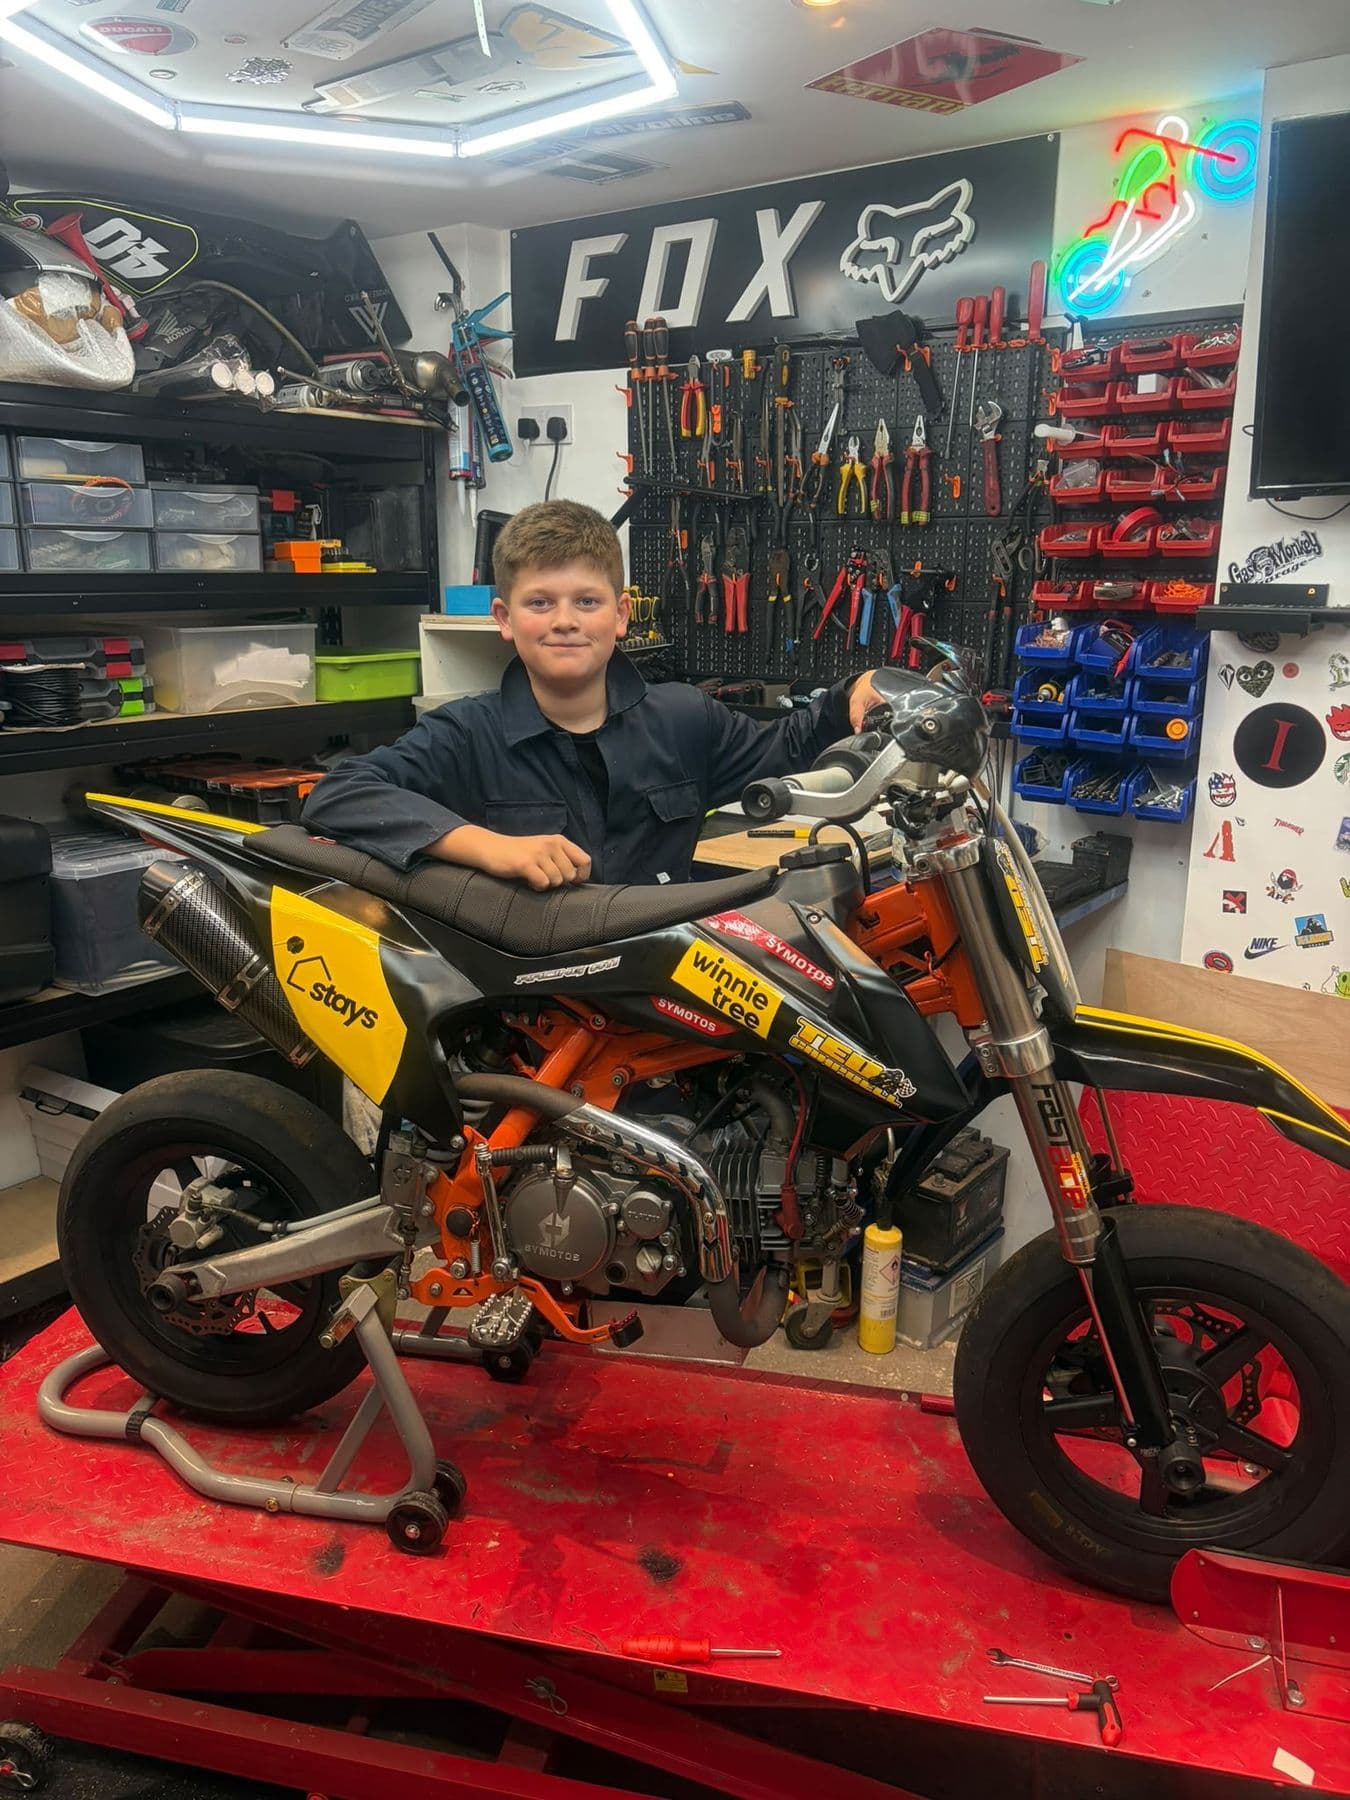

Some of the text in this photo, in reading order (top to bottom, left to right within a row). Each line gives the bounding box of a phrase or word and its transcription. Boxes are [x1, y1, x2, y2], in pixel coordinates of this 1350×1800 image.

[100, 26, 163, 34] DUCATI
[554, 200, 826, 342] FOX
[164, 324, 196, 344] HONDA
[1228, 530, 1322, 584] Gas Monkey
[1256, 559, 1308, 584] arage
[766, 936, 835, 987] SYMOTOS
[1250, 938, 1278, 949] NIKE
[692, 950, 769, 1011] winnie
[309, 982, 379, 1029] stays
[657, 997, 716, 1032] SYMOTOS
[712, 986, 761, 1030] tree
[797, 1017, 885, 1079] TED
[524, 1245, 581, 1262] SYMOTOS
